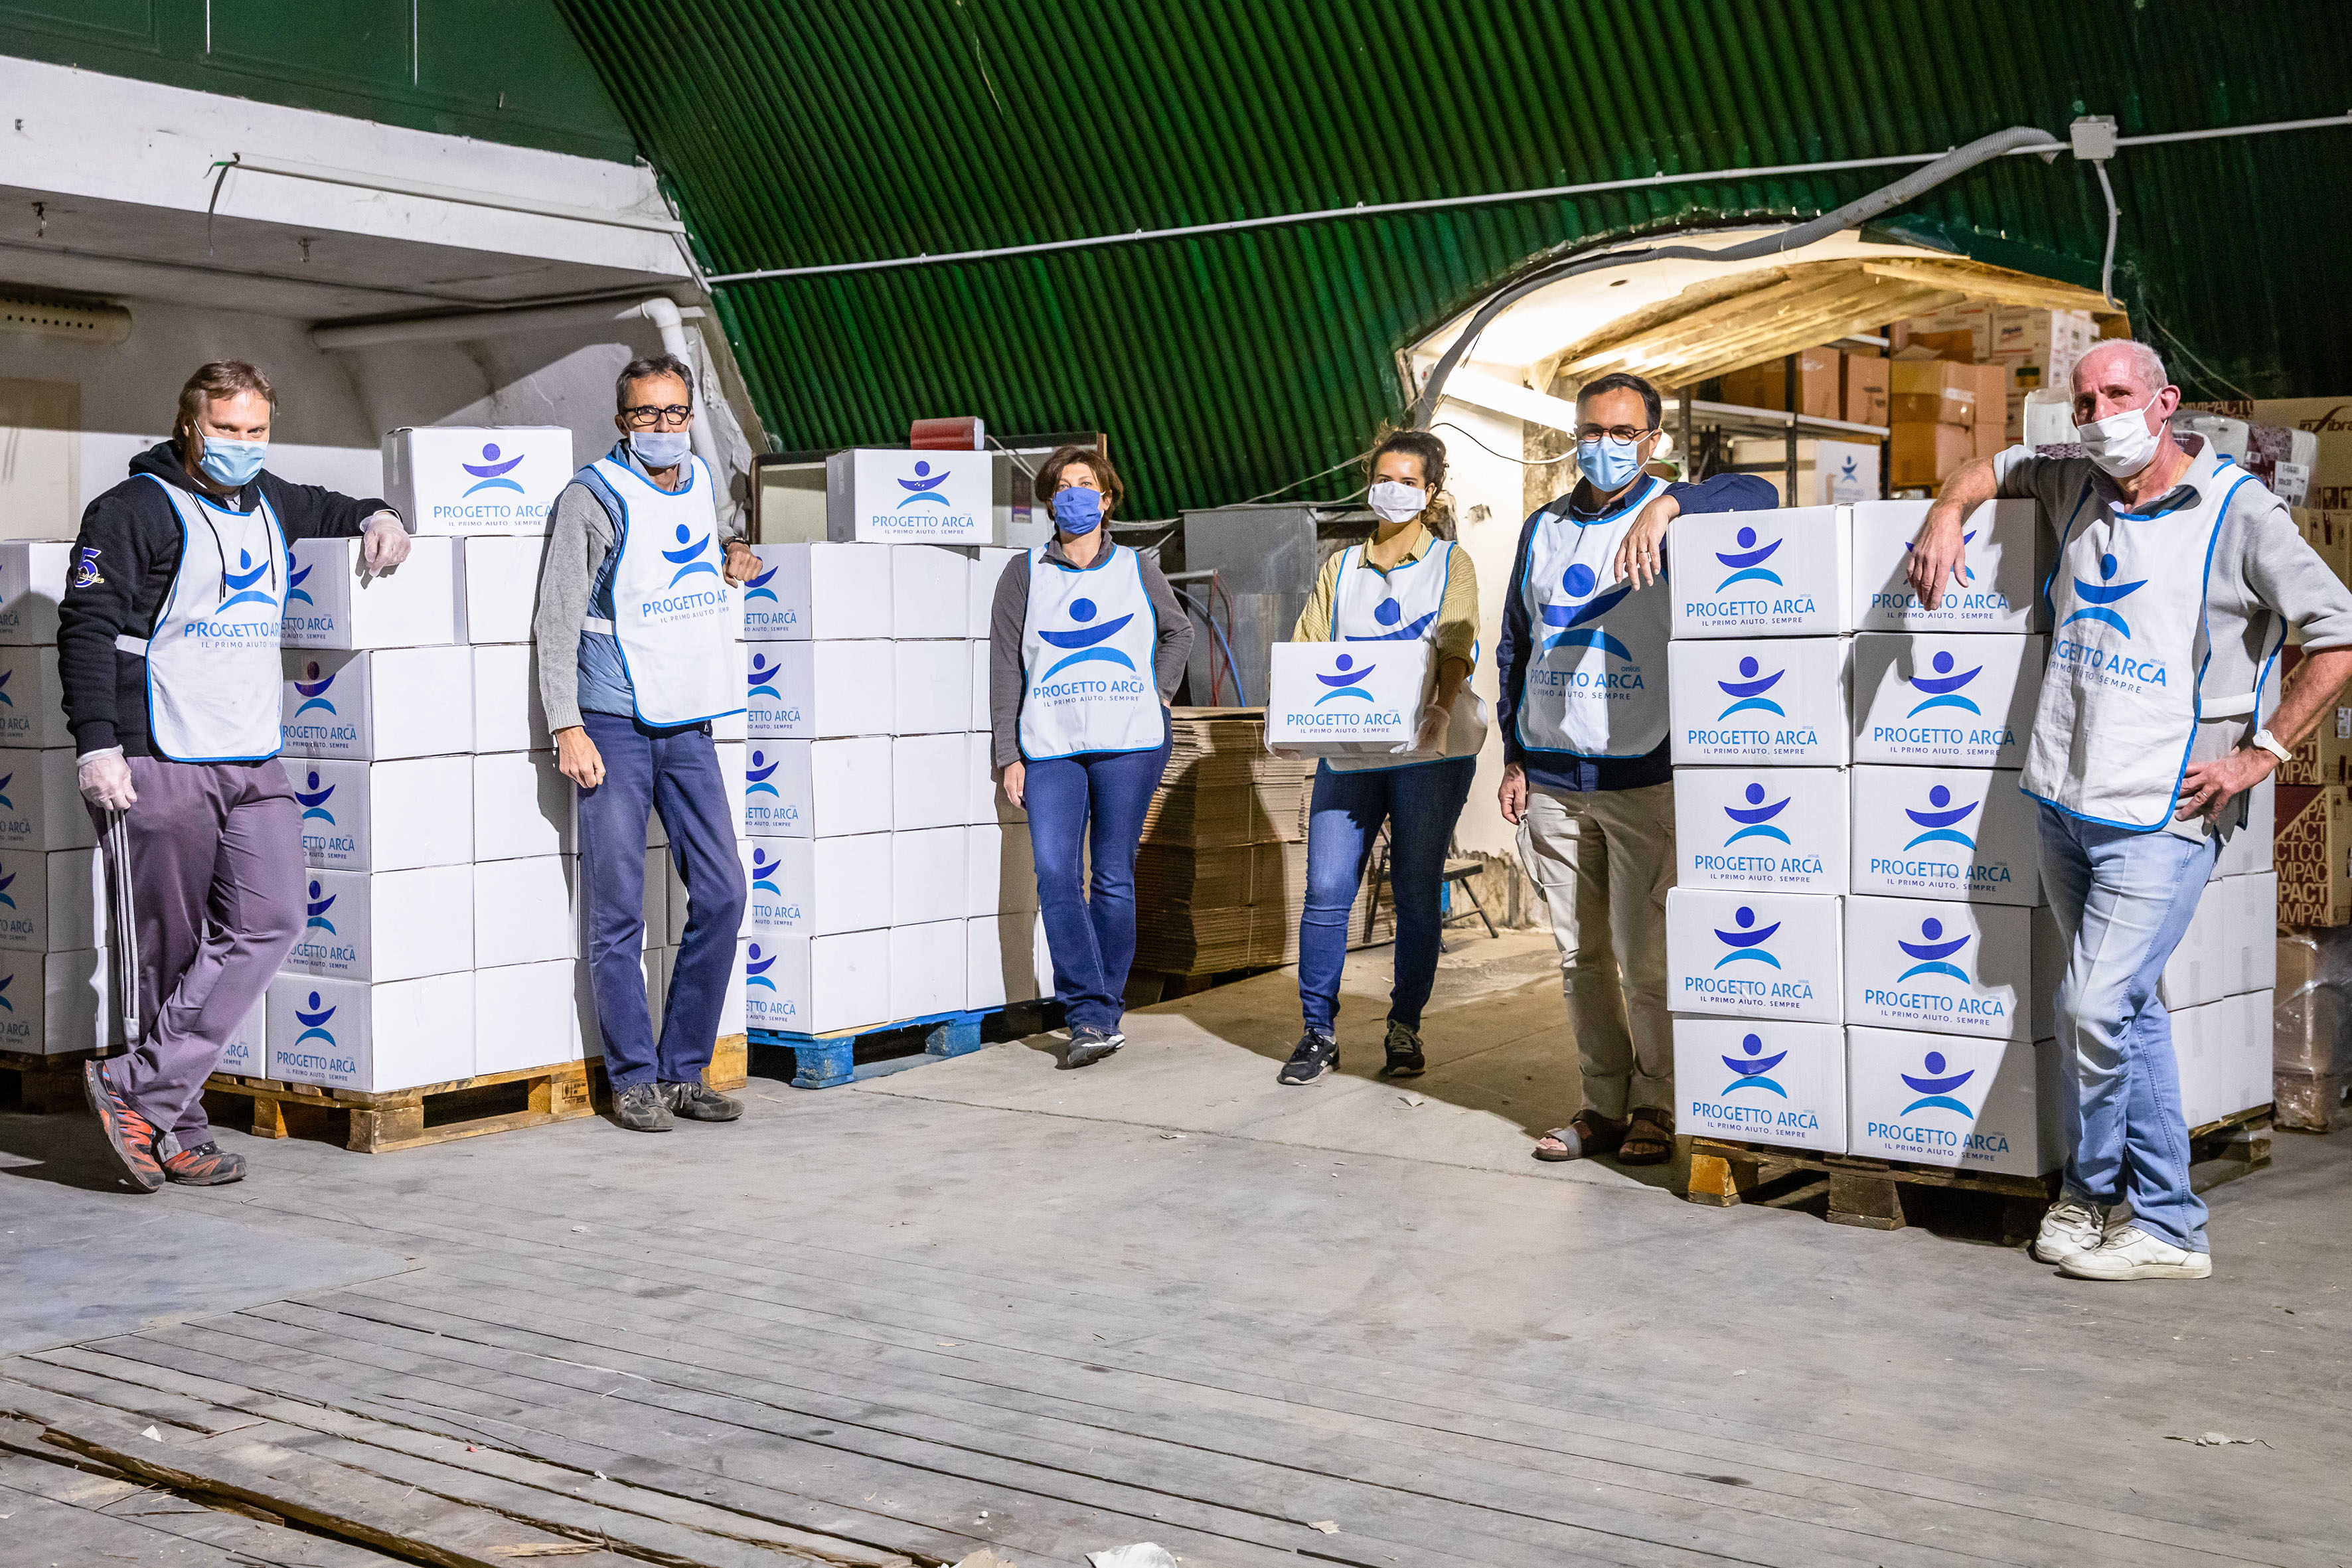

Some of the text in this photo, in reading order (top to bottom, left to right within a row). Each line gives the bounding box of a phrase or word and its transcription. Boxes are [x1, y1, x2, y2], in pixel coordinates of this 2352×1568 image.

[433, 505, 553, 518] PROGETTO ARCA
[872, 516, 974, 527] PROGETTO ARCA
[643, 591, 715, 617] PROGETTO
[1686, 599, 1816, 617] PROGETTO ARCA
[1963, 593, 2008, 609] ARCA
[307, 617, 334, 631] ARCA
[670, 613, 690, 621] PRIMO
[771, 612, 797, 624] ARCA
[184, 622, 269, 637] PROGETTO
[2051, 637, 2167, 687] OGETTO ARCA
[1530, 668, 1644, 690] PROGETTO ARCA
[2098, 674, 2142, 694] SEMPRE
[1033, 680, 1144, 699] PROGETTO ARCA
[1592, 692, 1631, 700] SEMPRE
[1054, 697, 1076, 706] PRIMO
[775, 710, 801, 722] ARCA
[1287, 713, 1401, 726] PROGETTO ARCA
[7, 718, 30, 730] ARCA
[283, 725, 356, 740] ROGETTO ARCA
[1688, 730, 1818, 745] PROGETTO ARCA
[1874, 727, 2015, 745] PROGETTO ARCA
[773, 808, 799, 819] ARCA
[9, 821, 31, 834] ARCA
[329, 837, 355, 851] ARCA
[1695, 855, 1823, 874] PROGETTO ARCA
[1871, 858, 2011, 883] PROGETTO ARCA
[775, 906, 801, 919] ARCA
[11, 920, 34, 933] ARCA
[291, 943, 356, 961] OGETTO ARCA
[1686, 977, 1813, 999] PROGETTO ARCA
[770, 1002, 796, 1015] ARCA
[1865, 989, 2005, 1016] PROGETTO ARCA
[1892, 1010, 1919, 1019] PRIMO
[1956, 1017, 1990, 1026] SEMPRE
[7, 1023, 30, 1036] ARCA
[277, 1051, 356, 1073] PROGETTO ARCA
[1693, 1102, 1818, 1130] PROGETTO ARCA
[1776, 1129, 1806, 1138] SEMPRE
[1868, 1122, 2009, 1153] PROGETTO ARCA
[1896, 1144, 1922, 1153] PRIMO
[1961, 1152, 1995, 1162] SEMPRE
